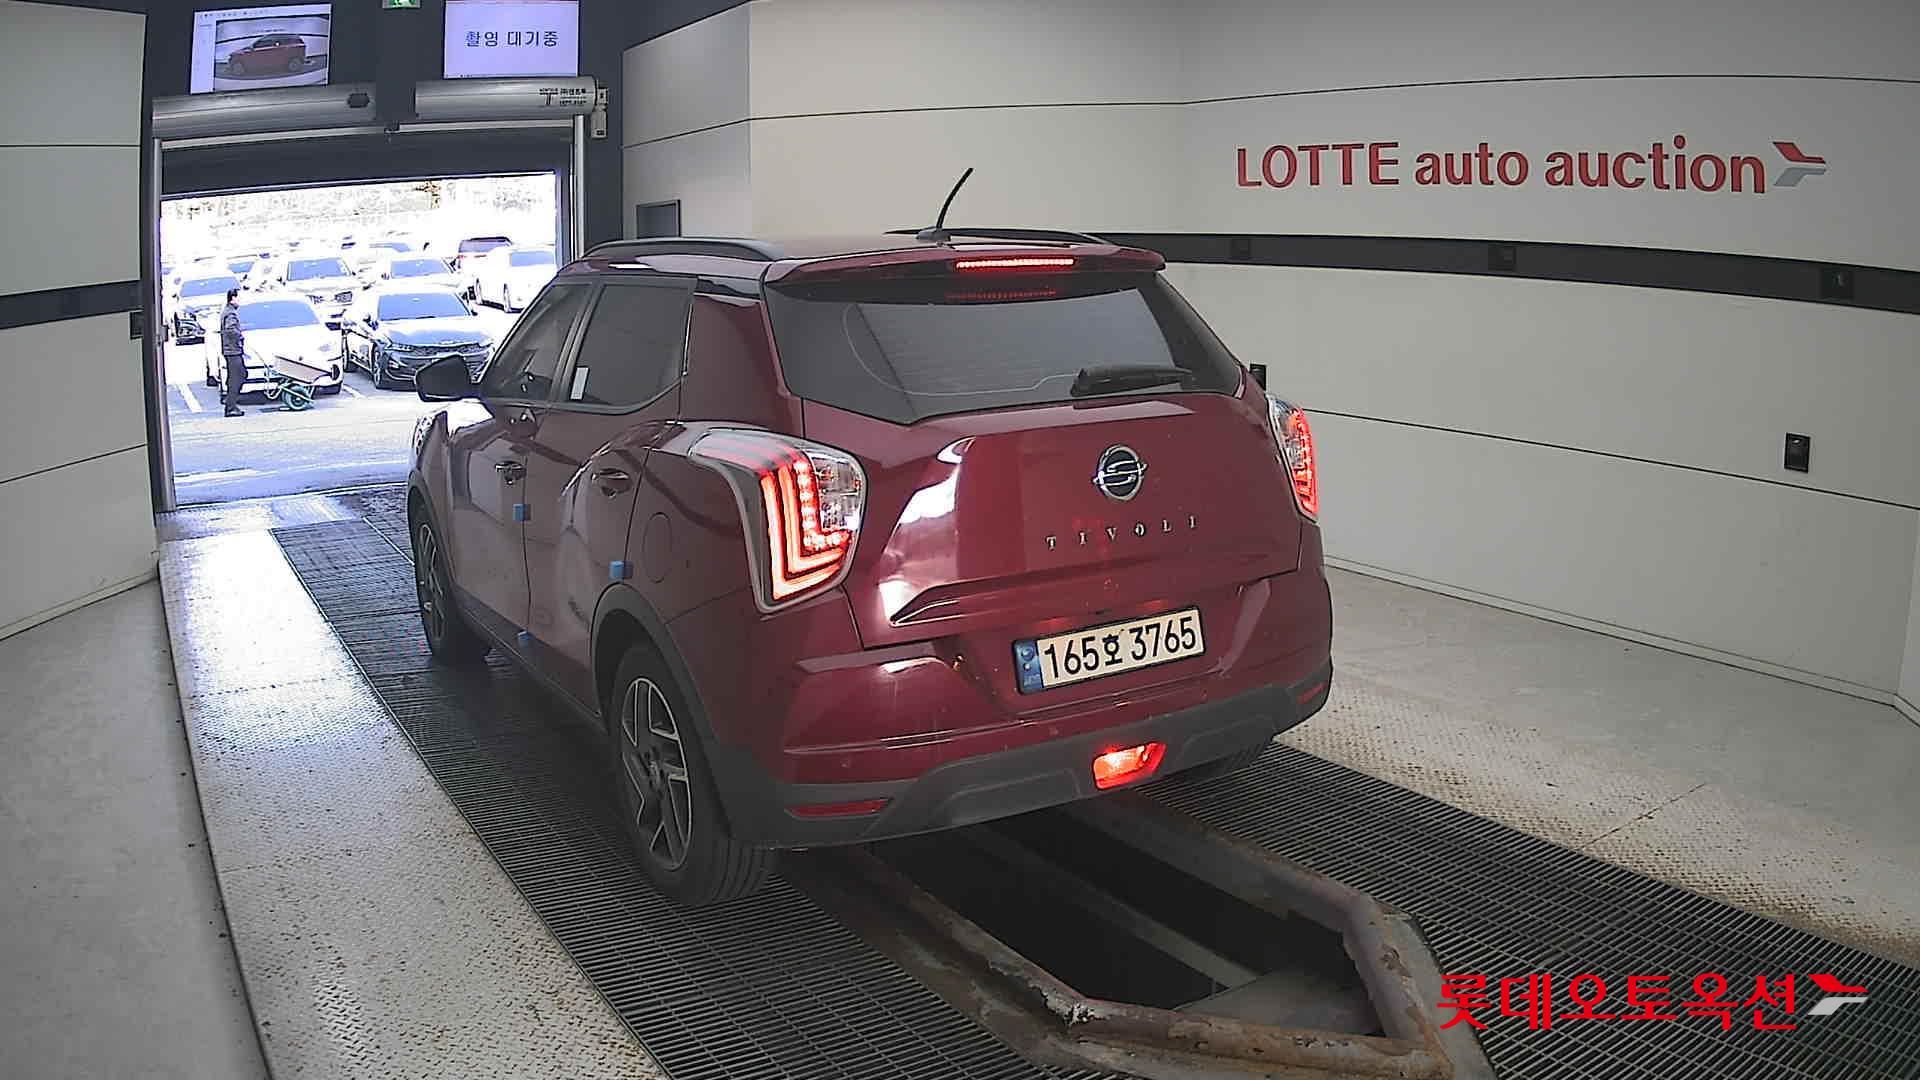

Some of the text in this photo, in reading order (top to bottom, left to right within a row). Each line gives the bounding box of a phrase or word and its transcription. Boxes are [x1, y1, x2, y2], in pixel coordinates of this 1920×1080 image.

[466, 31, 558, 47] 촬영 대기중
[1237, 135, 1766, 194] LOTTE auto auction
[1046, 515, 1196, 550] TIVOLI
[1044, 616, 1196, 679] 165호 3765
